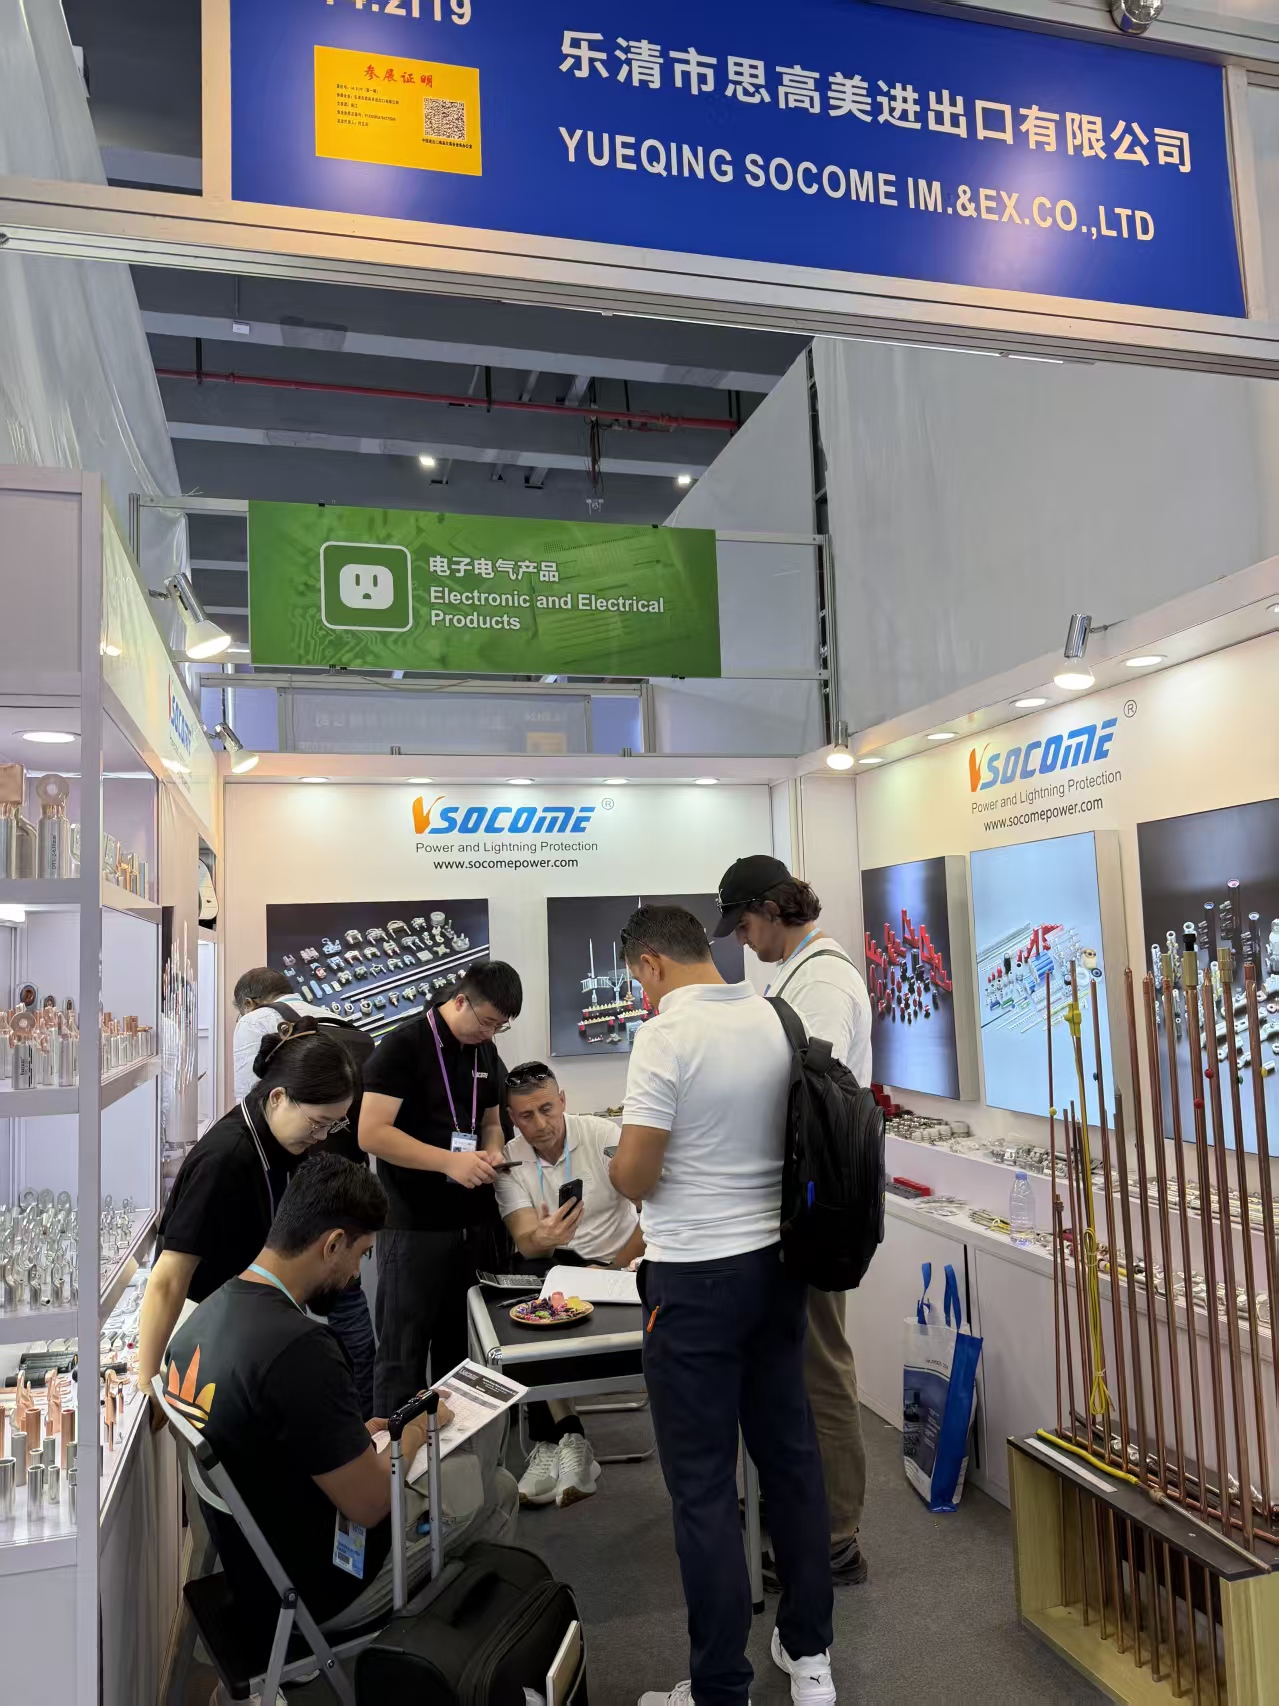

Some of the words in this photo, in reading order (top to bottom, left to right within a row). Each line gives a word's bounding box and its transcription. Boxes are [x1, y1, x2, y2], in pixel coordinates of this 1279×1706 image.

[364, 64, 433, 89] 参展证明
[558, 30, 1192, 174] 乐清市思高美进出口有限公司
[558, 126, 734, 183] YUEQING
[744, 153, 898, 207] SOCOME
[907, 176, 1155, 241] IM.&EX.CO.,LTD
[429, 555, 560, 583] 电子电气产品
[430, 586, 531, 608] Electronic
[536, 593, 572, 610] and
[578, 593, 665, 613] Electrical
[431, 609, 521, 630] Products
[971, 797, 999, 814] Power
[1000, 789, 1018, 808] and
[1019, 782, 1065, 804] Lightning
[1067, 769, 1122, 793] Protection
[983, 797, 1104, 832] www.socomepower.com
[415, 842, 454, 854] Power
[457, 841, 480, 853] and
[483, 841, 537, 854] Lightning
[540, 840, 598, 852] Protection
[433, 857, 579, 871] www.socomepower.com
